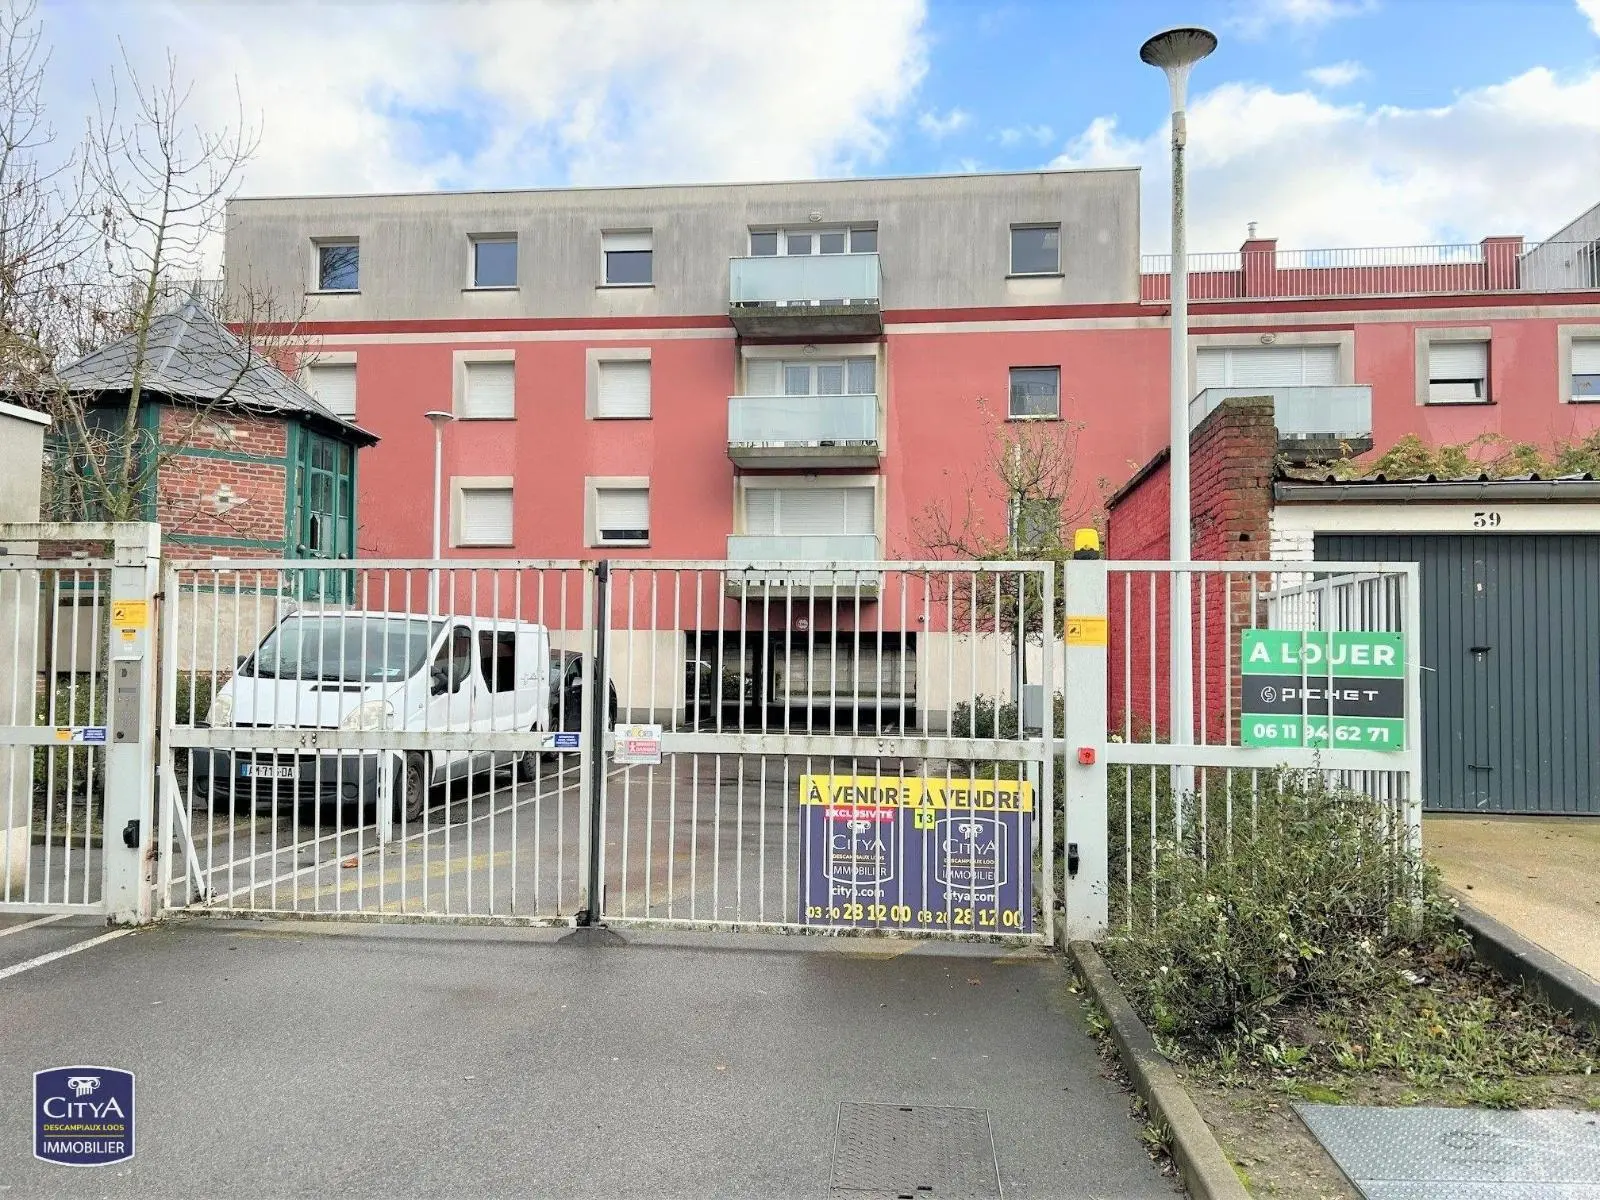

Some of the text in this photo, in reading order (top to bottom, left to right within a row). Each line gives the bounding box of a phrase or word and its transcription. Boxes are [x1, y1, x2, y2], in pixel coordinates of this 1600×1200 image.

[1250, 642, 1395, 666] A LOUER
[1282, 688, 1379, 702] PICHET
[1254, 724, 1389, 742] 06 11 94 62 71
[828, 786, 910, 806] VENDRE
[940, 789, 1024, 809] VENDRE
[825, 808, 894, 819] EXCLSIVTÉ
[916, 813, 933, 824] T3
[832, 866, 887, 876] MMBILIR
[942, 870, 996, 880] IMMOILIE
[807, 906, 822, 918] 03
[843, 904, 864, 920] 28
[868, 904, 886, 920] 12
[891, 906, 912, 922] 00
[918, 910, 932, 922] 03
[954, 908, 972, 925] 28
[979, 908, 996, 926] 12
[1002, 910, 1022, 926] 00
